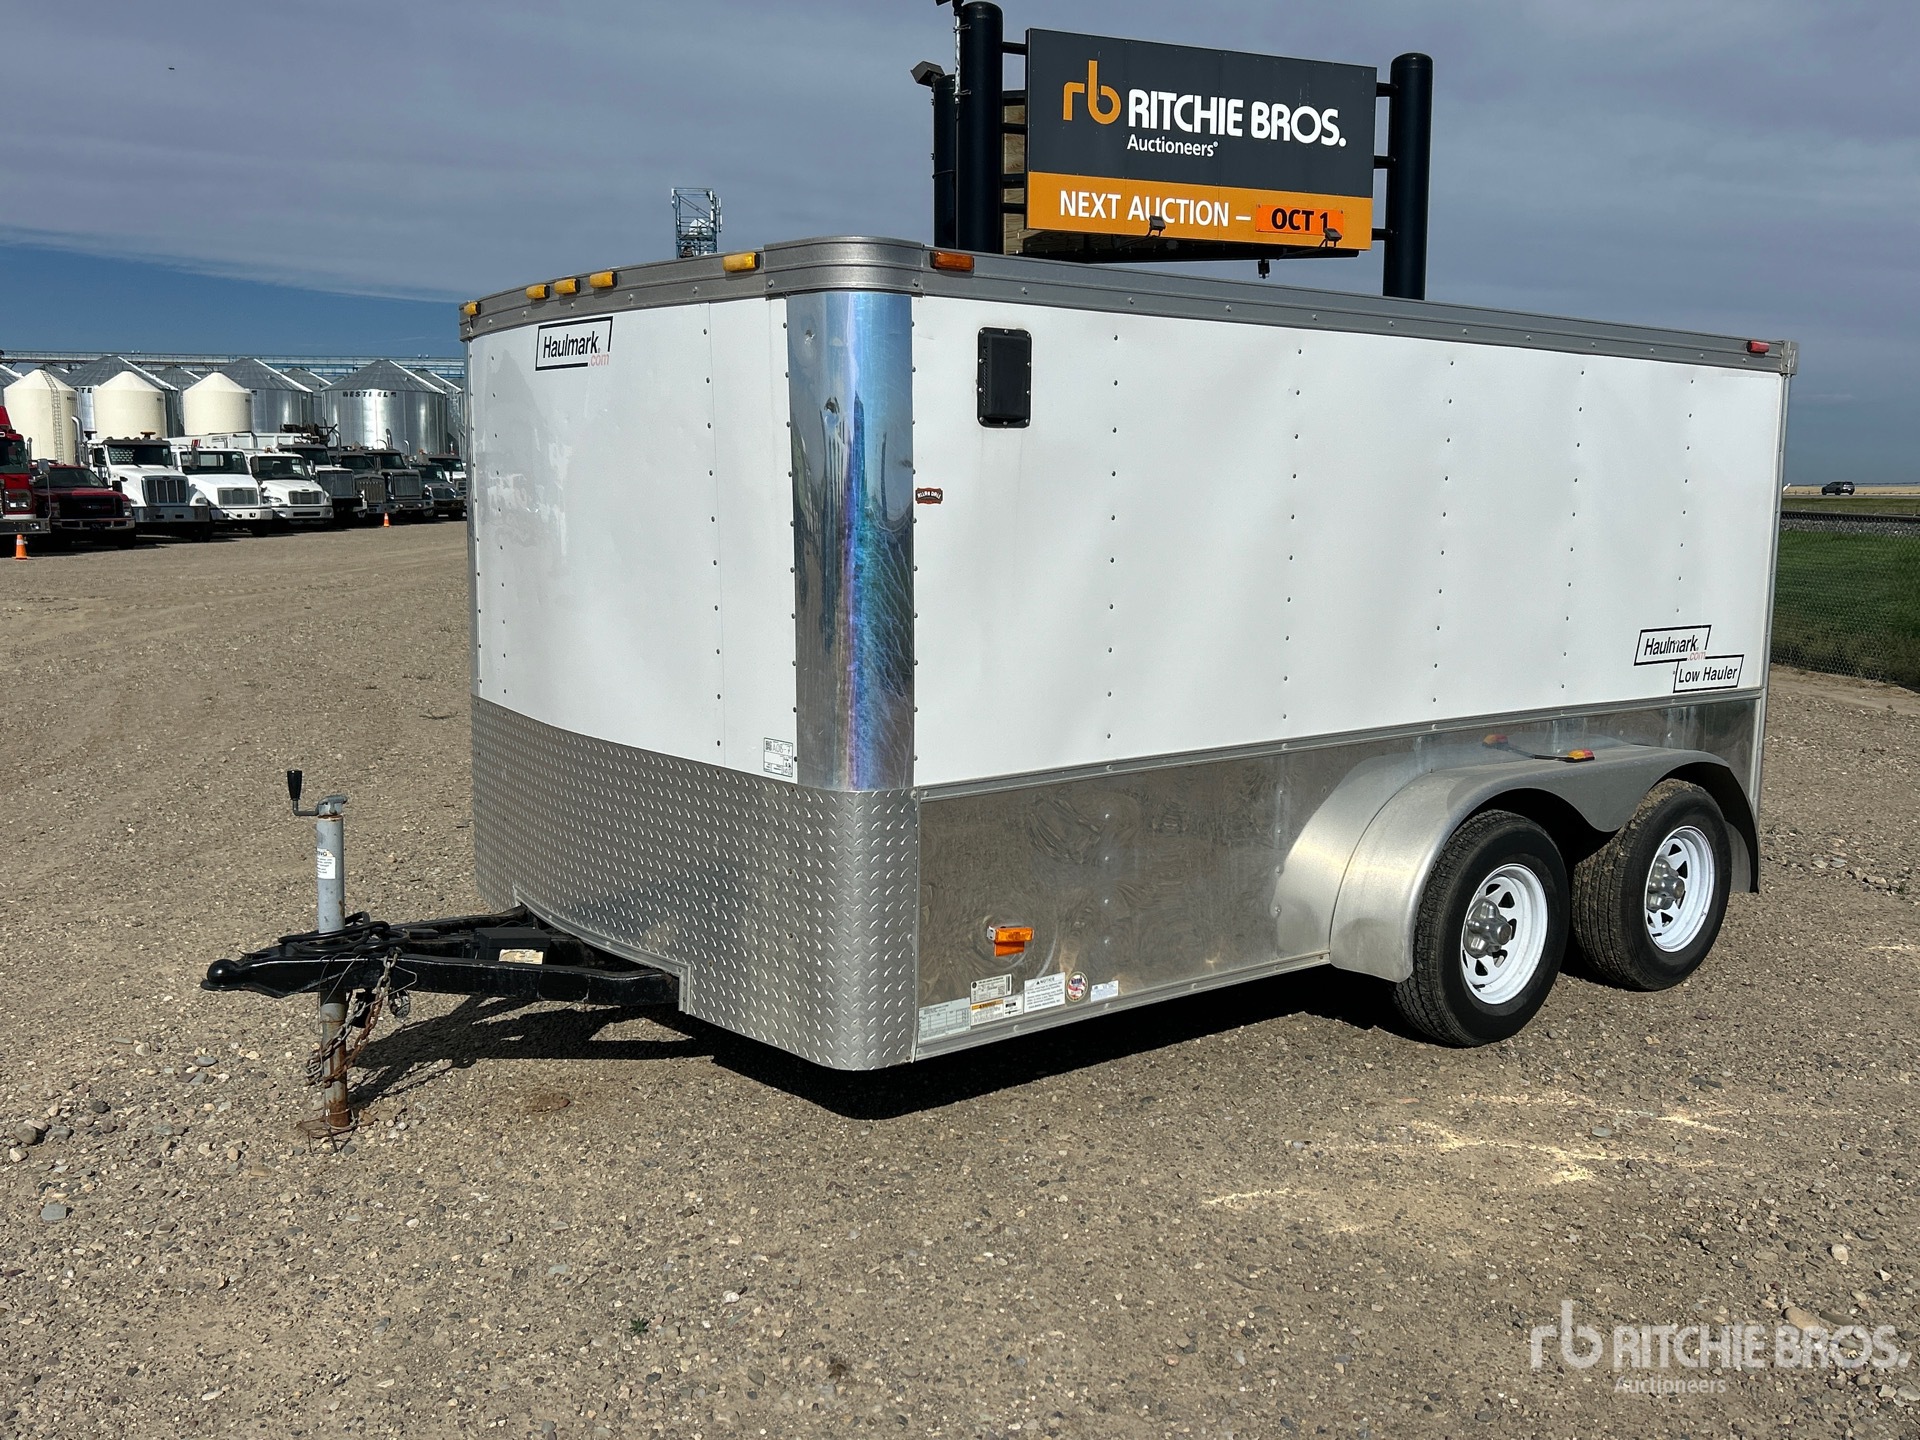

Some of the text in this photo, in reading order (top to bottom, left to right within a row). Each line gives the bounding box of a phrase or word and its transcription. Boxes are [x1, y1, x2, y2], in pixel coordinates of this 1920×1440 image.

[1062, 59, 1121, 125] rb
[1128, 88, 1347, 148] RITCHIE BROS.
[1059, 190, 1121, 220] NEXT
[1127, 195, 1229, 227] AUCTION
[1271, 207, 1314, 231] OCT
[1319, 212, 1328, 232] 1
[543, 331, 599, 358] Haulmark
[1643, 635, 1699, 656] Haulmark
[1678, 665, 1738, 683] Low Hauler
